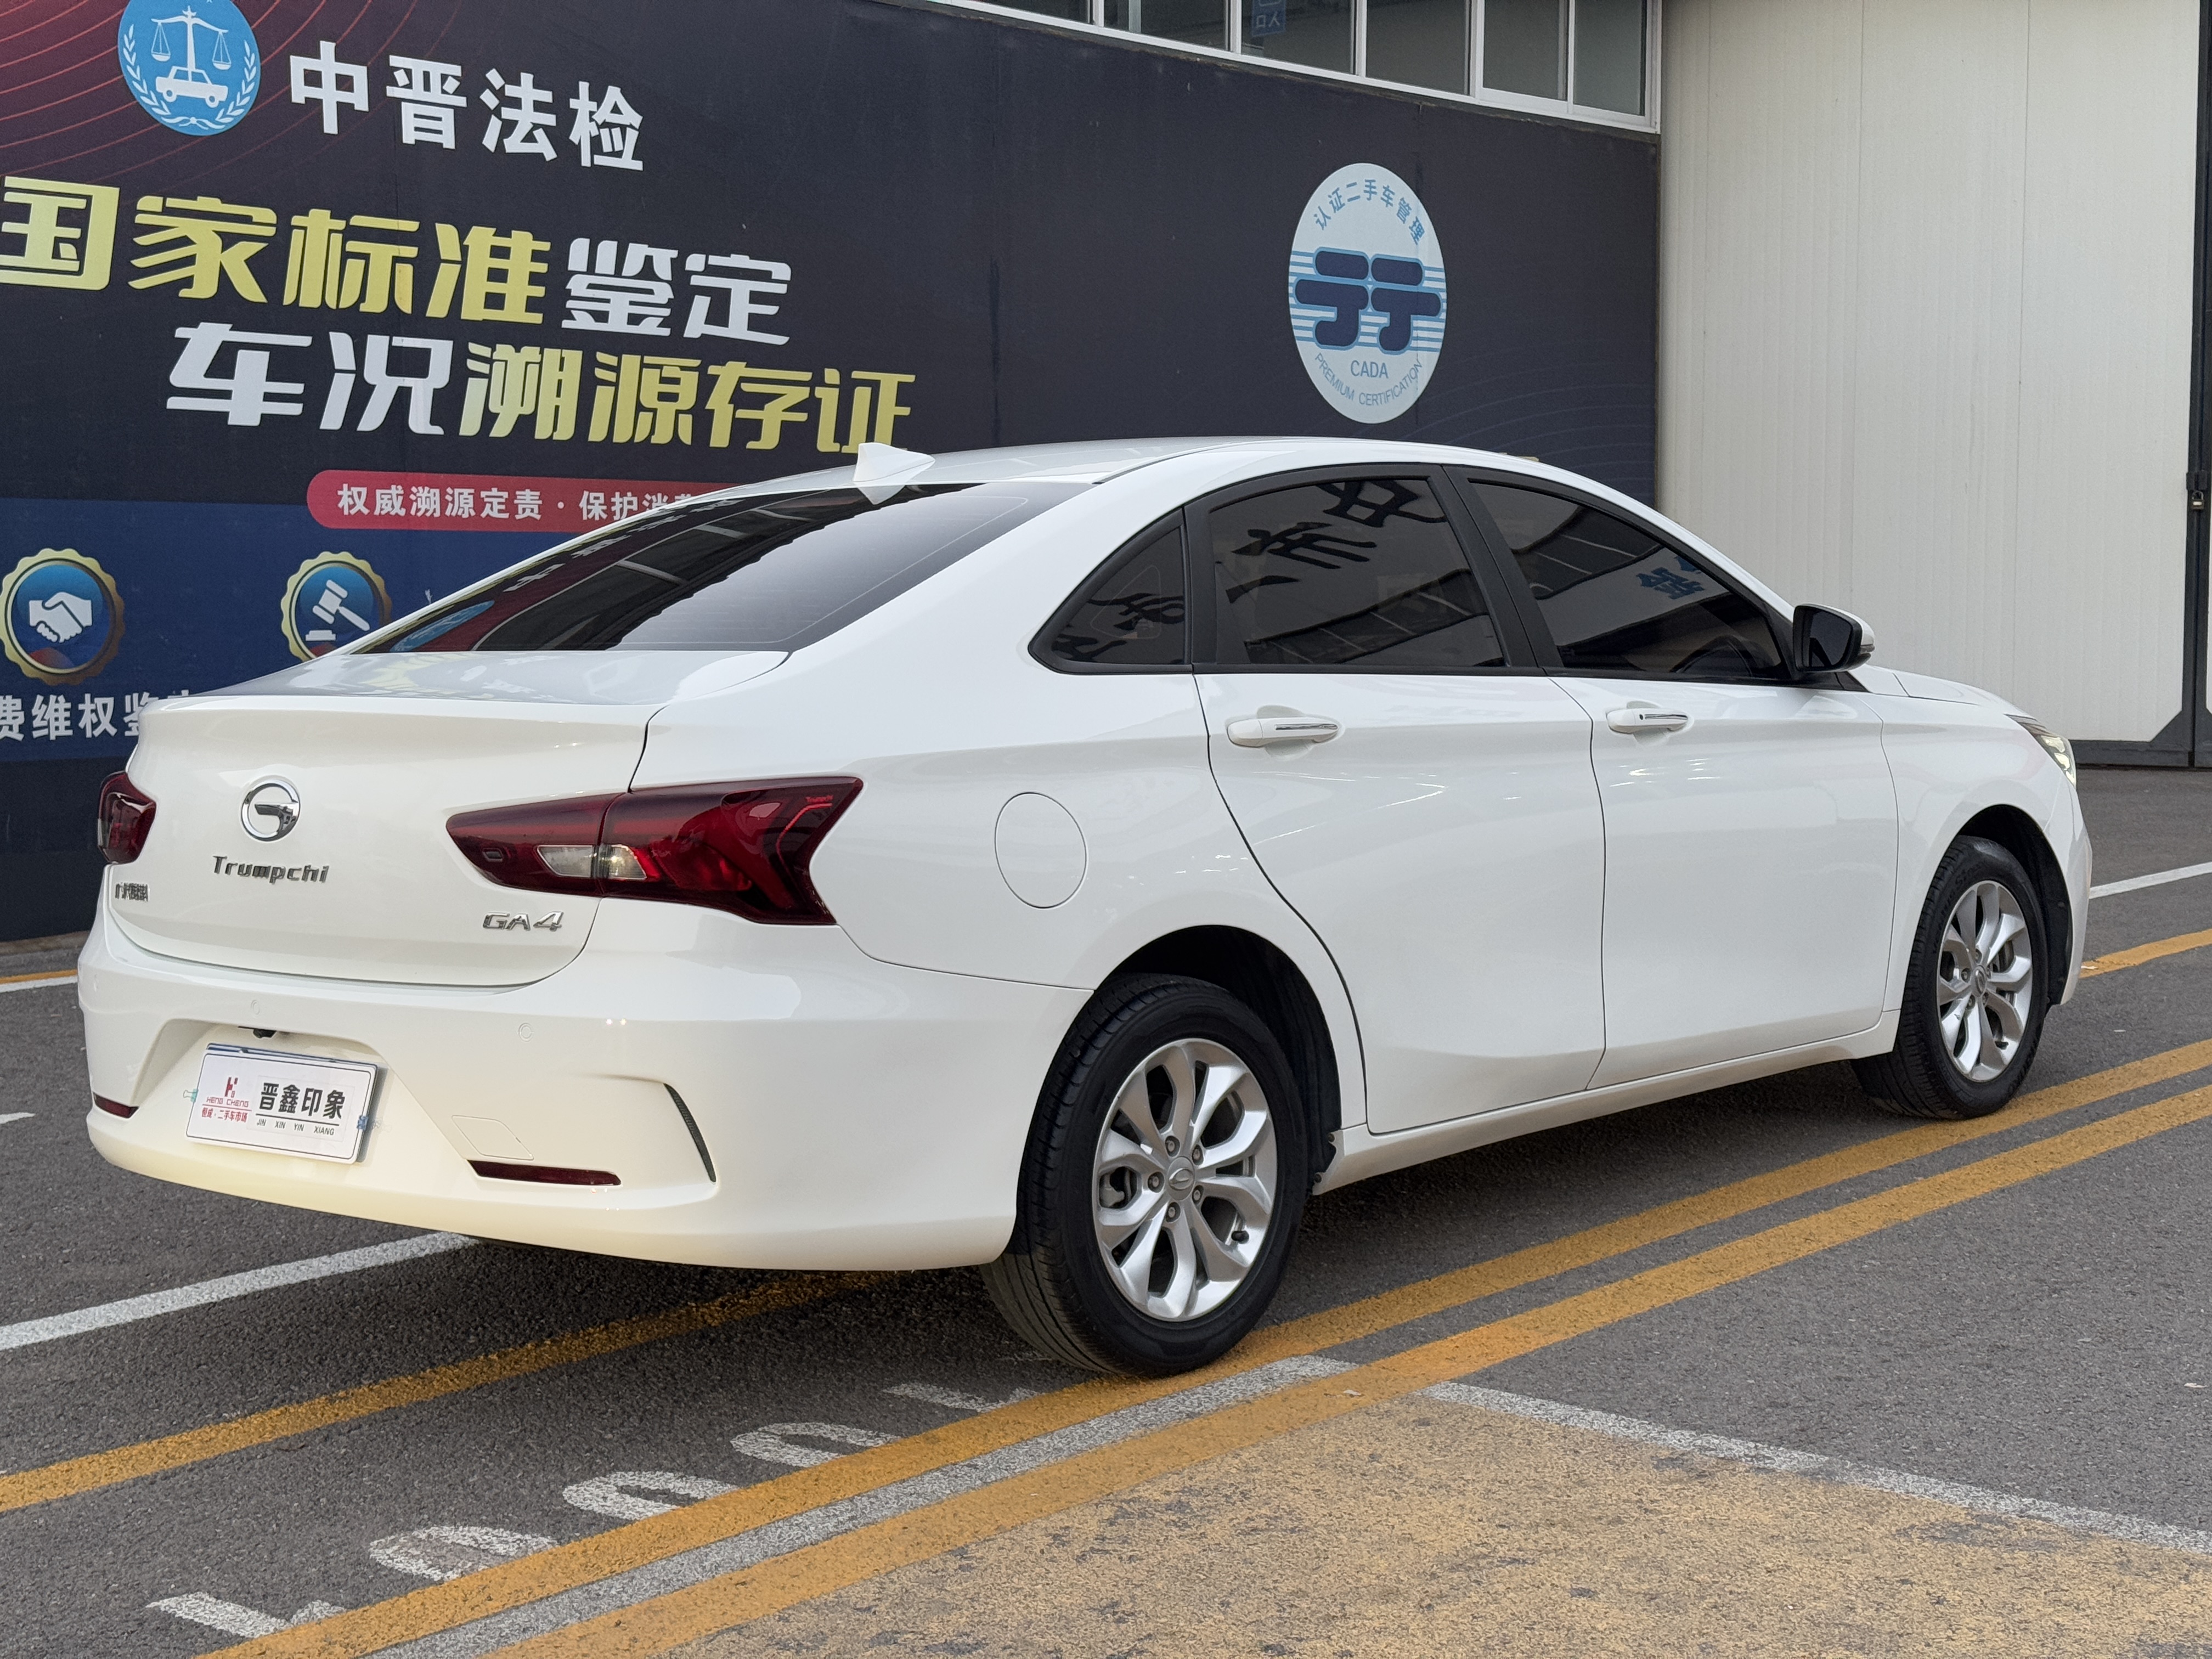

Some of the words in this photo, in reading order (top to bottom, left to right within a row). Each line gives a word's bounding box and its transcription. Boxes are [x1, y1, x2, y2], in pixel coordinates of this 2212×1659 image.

[290, 40, 643, 171] 中晋法检
[1313, 179, 1425, 245] 认证二手车管理
[0, 176, 791, 346] 国家标准鉴定
[166, 322, 916, 453] 车况溯源存证
[1315, 353, 1355, 401] PREMIUM
[1358, 358, 1423, 405] CERTIFICATION
[1351, 360, 1389, 379] CADA
[212, 855, 330, 884] Trumpchi
[482, 911, 565, 932] GA4
[259, 1082, 345, 1119] 晋鑫印象
[275, 1121, 286, 1129] XIN
[294, 1123, 304, 1131] YIN
[314, 1126, 335, 1136] XIANG
